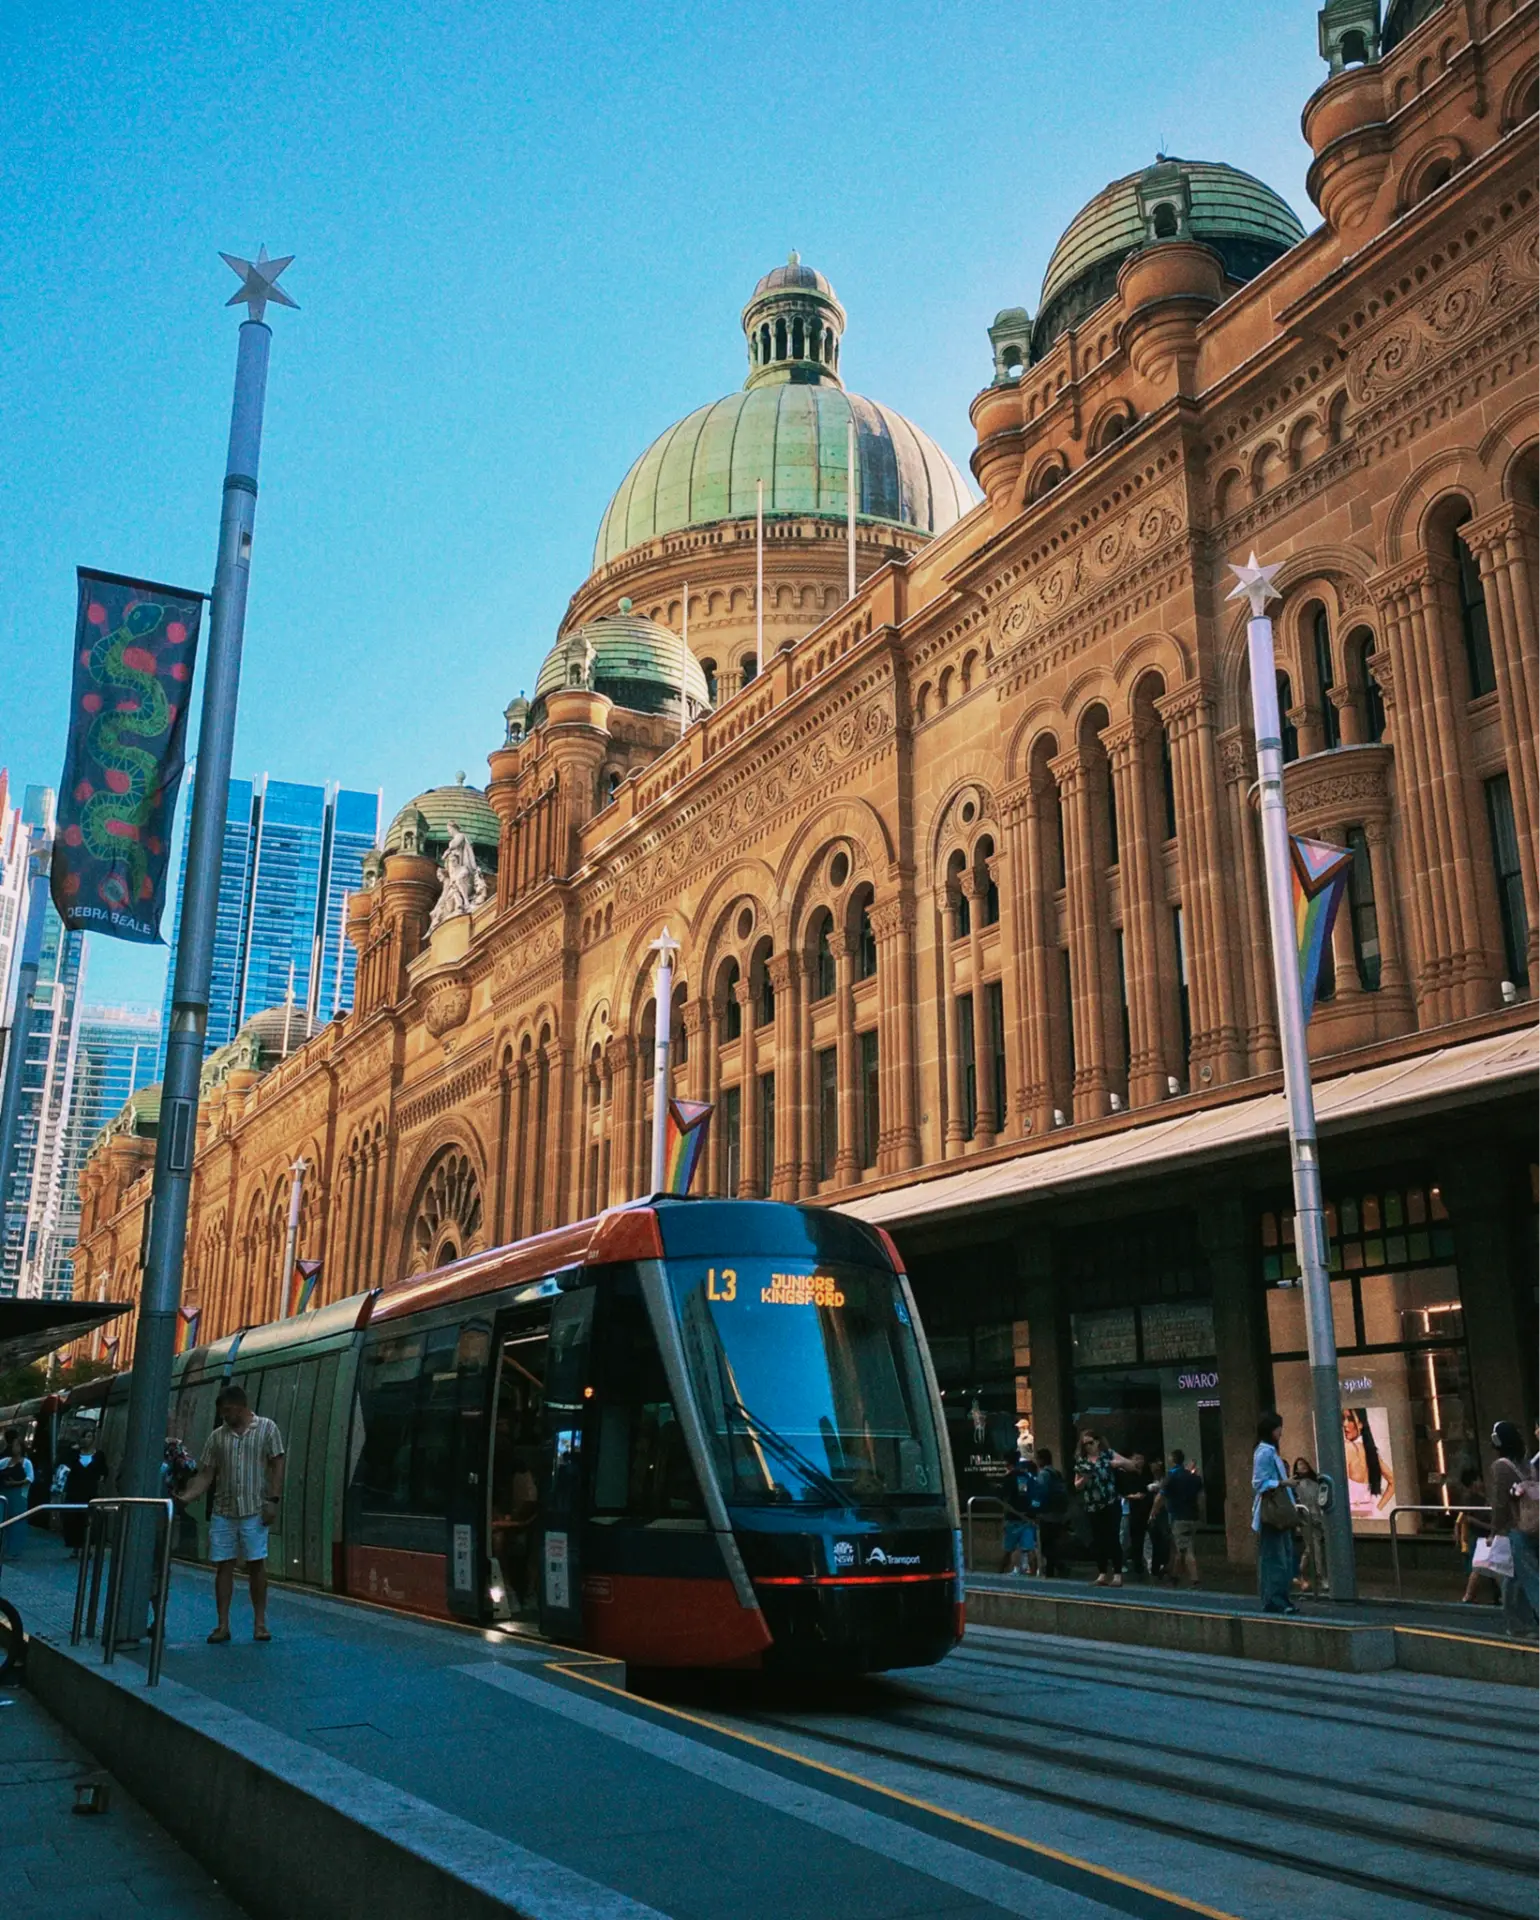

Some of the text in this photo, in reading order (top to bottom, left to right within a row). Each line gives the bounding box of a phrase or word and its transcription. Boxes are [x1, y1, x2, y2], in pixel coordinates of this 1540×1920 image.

[68, 907, 151, 934] DEBRA BEALE
[707, 1268, 737, 1301] L3
[771, 1274, 836, 1292] JUNIORS
[760, 1288, 844, 1307] KINGSFORD
[834, 1555, 854, 1563] NSW
[886, 1554, 921, 1565] Transport
